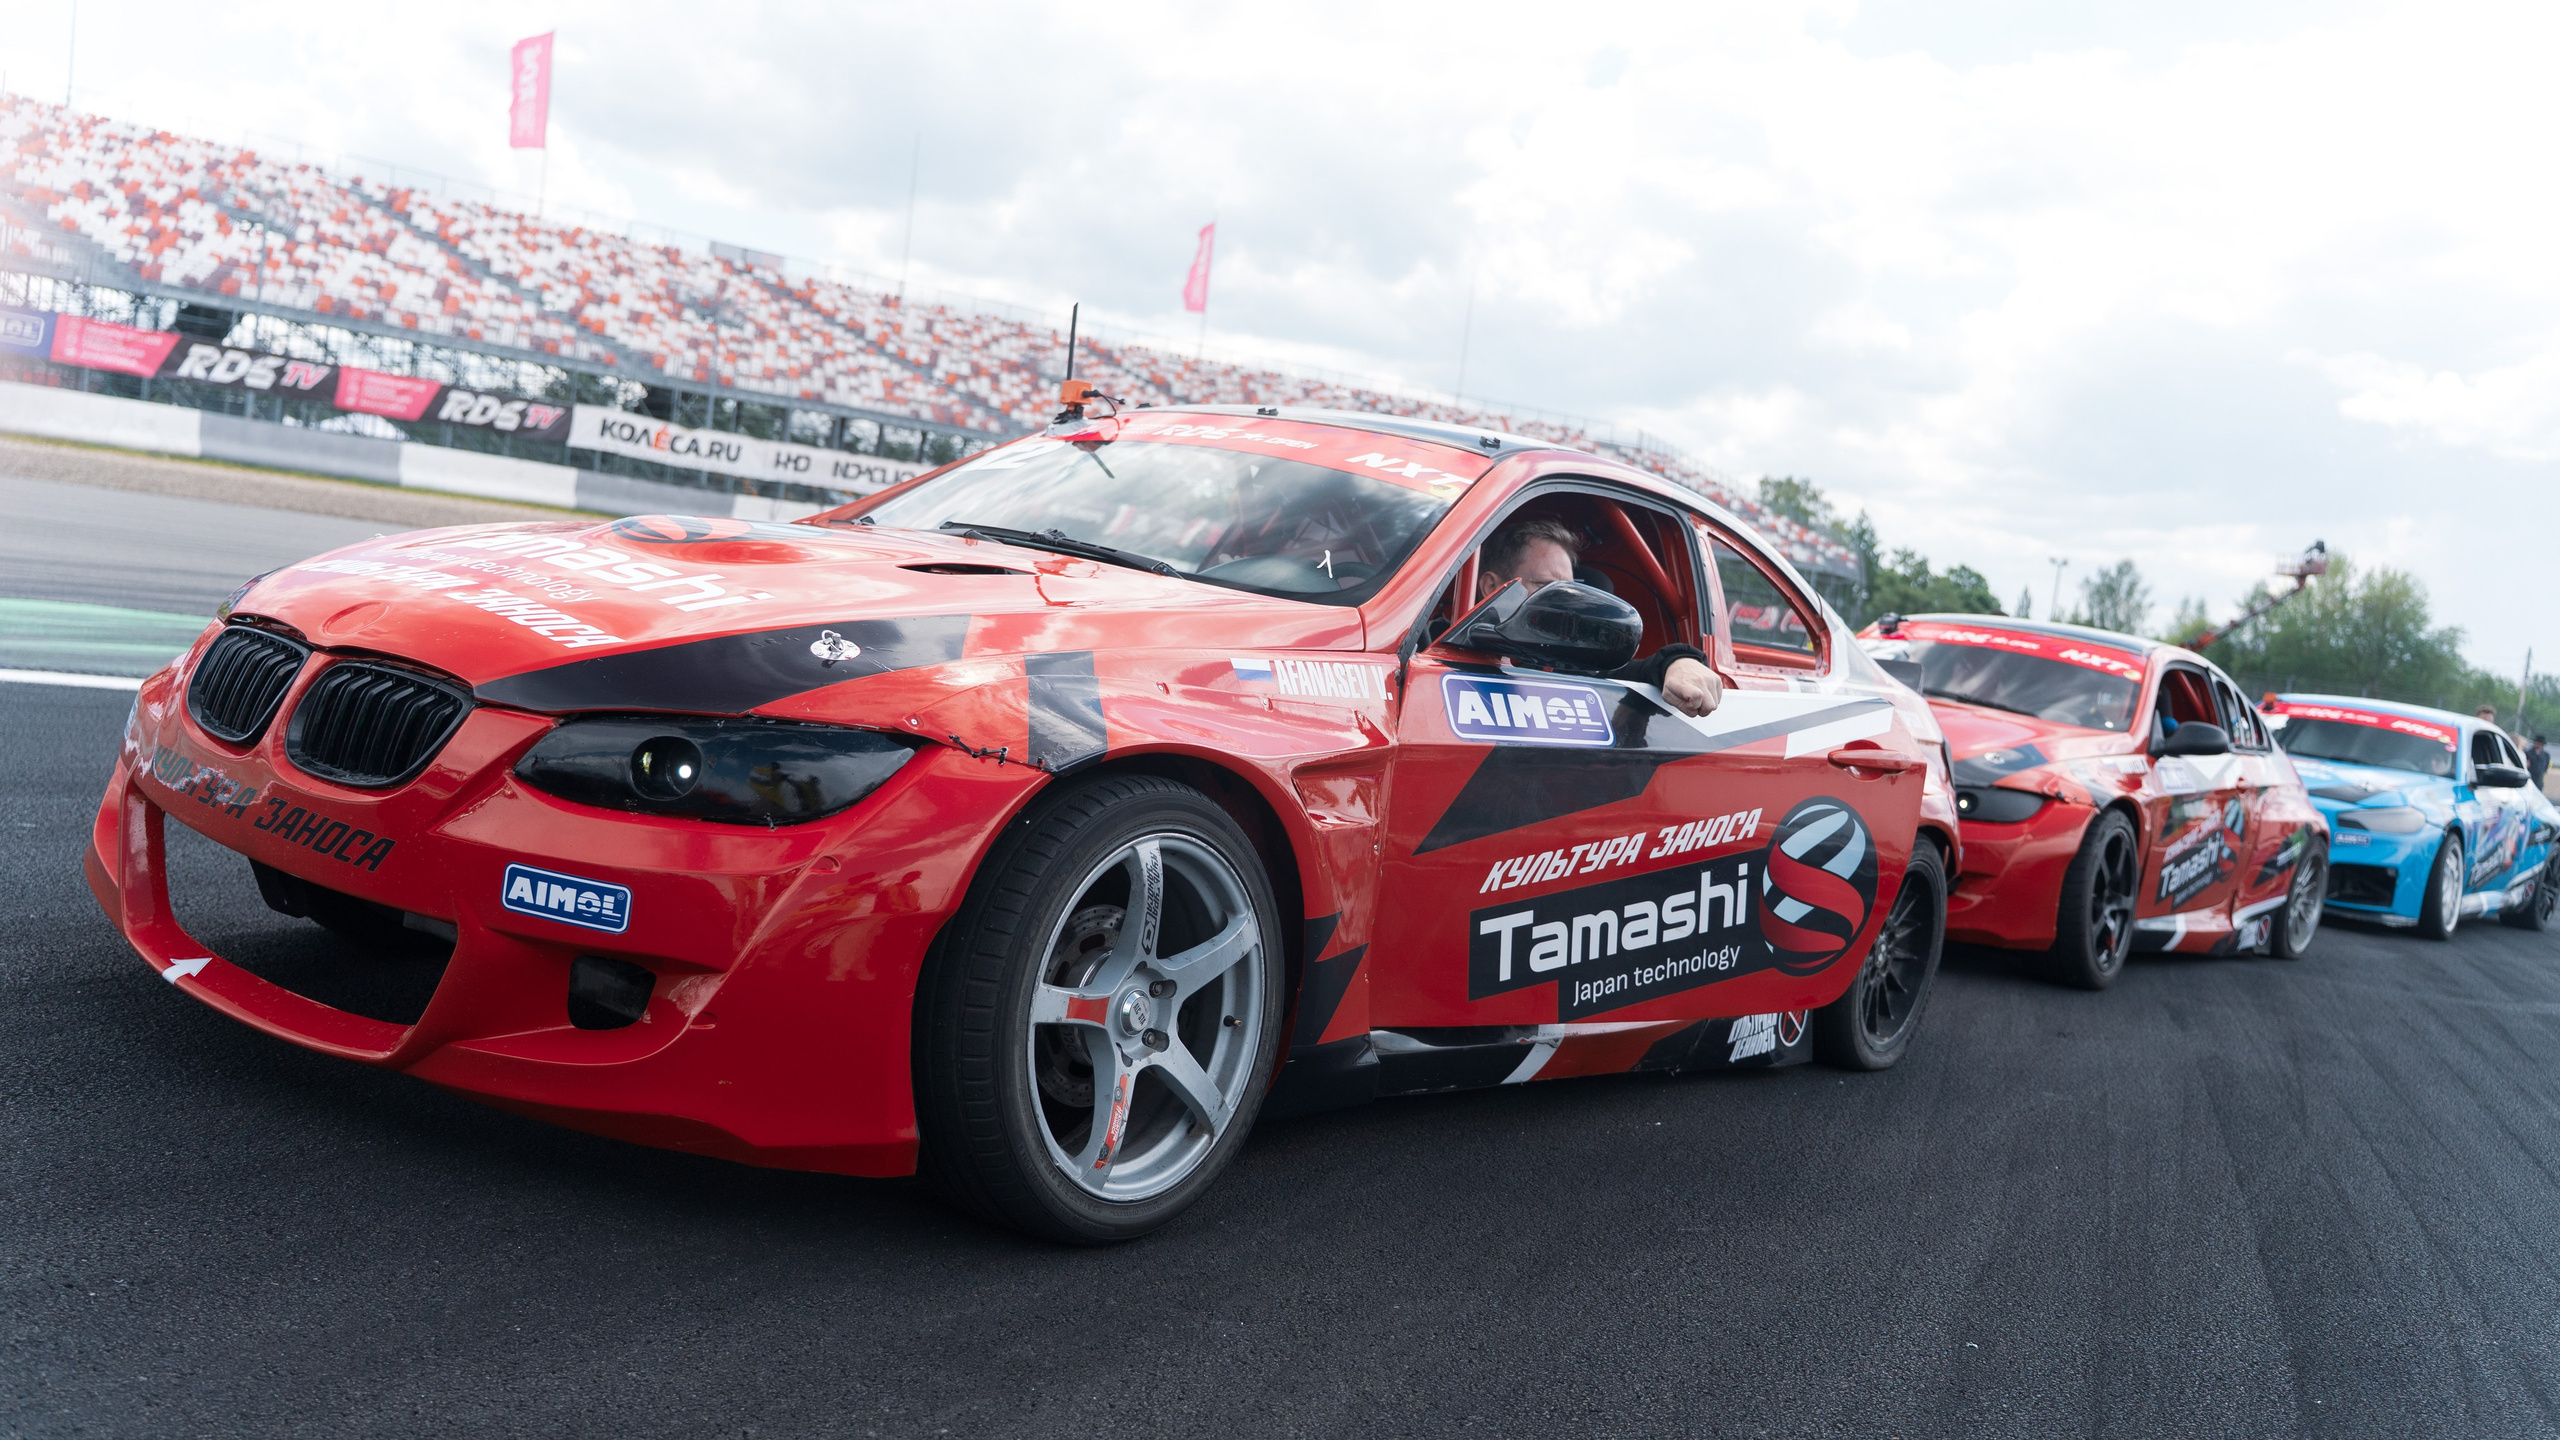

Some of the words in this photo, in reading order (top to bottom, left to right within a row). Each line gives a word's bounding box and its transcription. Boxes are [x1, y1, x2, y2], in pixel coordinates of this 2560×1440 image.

[176, 343, 287, 390] RDS
[280, 360, 332, 390] TV
[438, 389, 527, 431] RDS
[523, 404, 565, 429] TV
[1344, 452, 1474, 486] NXT
[461, 557, 604, 603] technology
[445, 588, 627, 649] ЗАНОСА
[1274, 660, 1371, 699] AFANASEV
[2059, 648, 2132, 671] NXT
[1457, 690, 1605, 732] AIMOL
[254, 797, 397, 873] ЗАНОСА
[1479, 832, 1647, 894] КУЛЬТУРА
[1649, 807, 1763, 860] ЗАНОСА
[508, 875, 622, 919] AIMOL
[1479, 862, 1749, 982] Tamashi
[1573, 972, 1628, 1007] Japan
[1634, 944, 1741, 987] technology
